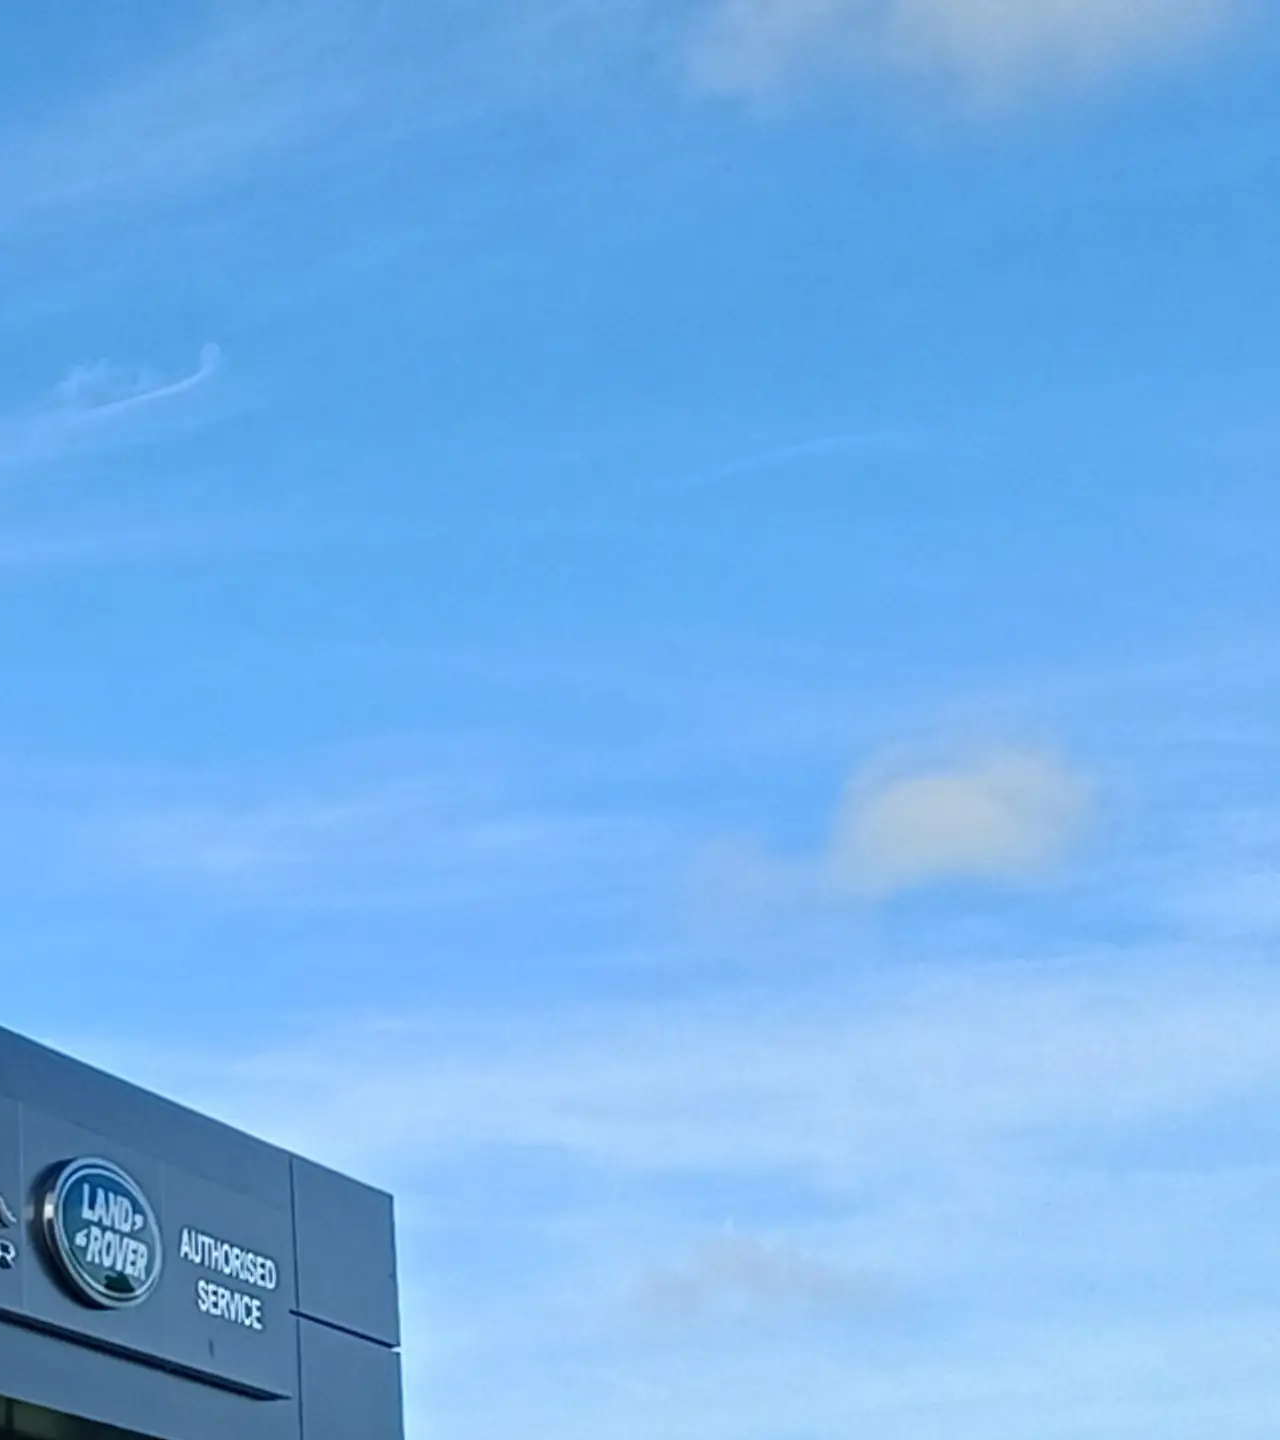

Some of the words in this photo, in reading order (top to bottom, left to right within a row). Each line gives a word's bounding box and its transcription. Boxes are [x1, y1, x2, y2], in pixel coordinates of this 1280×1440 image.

[81, 1182, 135, 1234] LAND
[86, 1226, 149, 1281] ROVER
[179, 1227, 278, 1290] AUTHORISED
[197, 1279, 264, 1330] SERVICE
